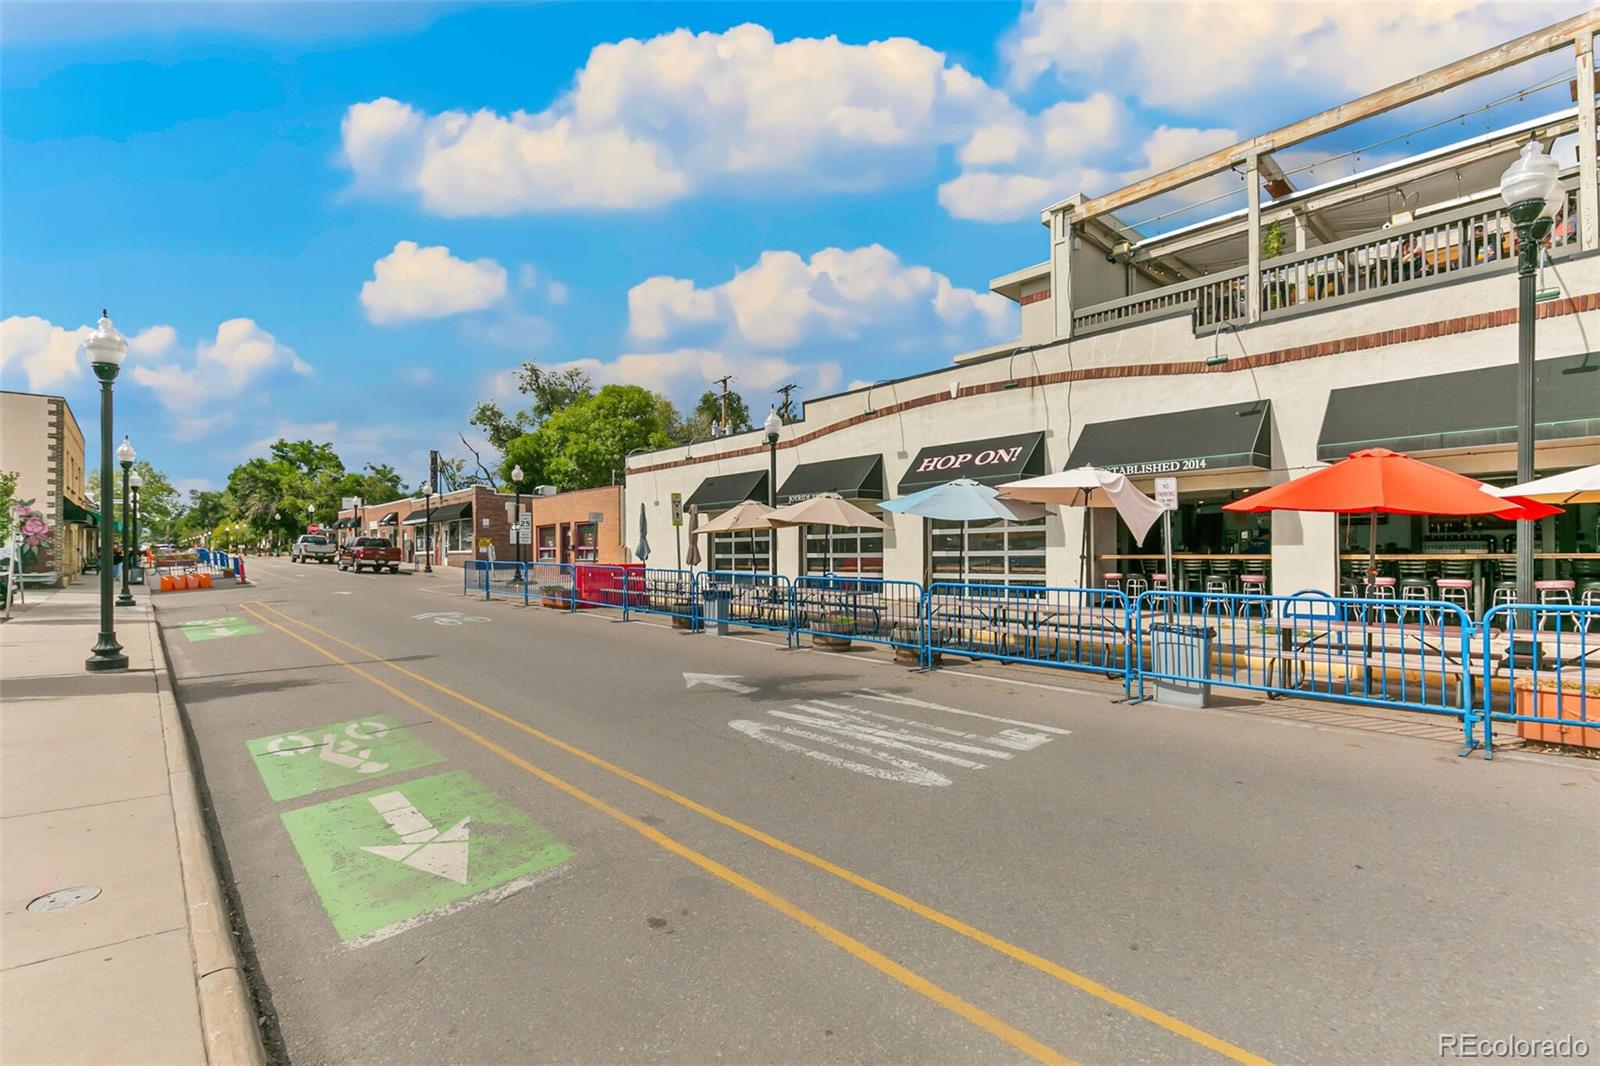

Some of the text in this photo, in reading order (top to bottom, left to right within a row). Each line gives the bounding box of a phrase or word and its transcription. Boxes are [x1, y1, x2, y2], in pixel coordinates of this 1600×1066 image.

[916, 446, 1023, 472] HOP ON!
[1103, 459, 1207, 476] TABLISHED 2014
